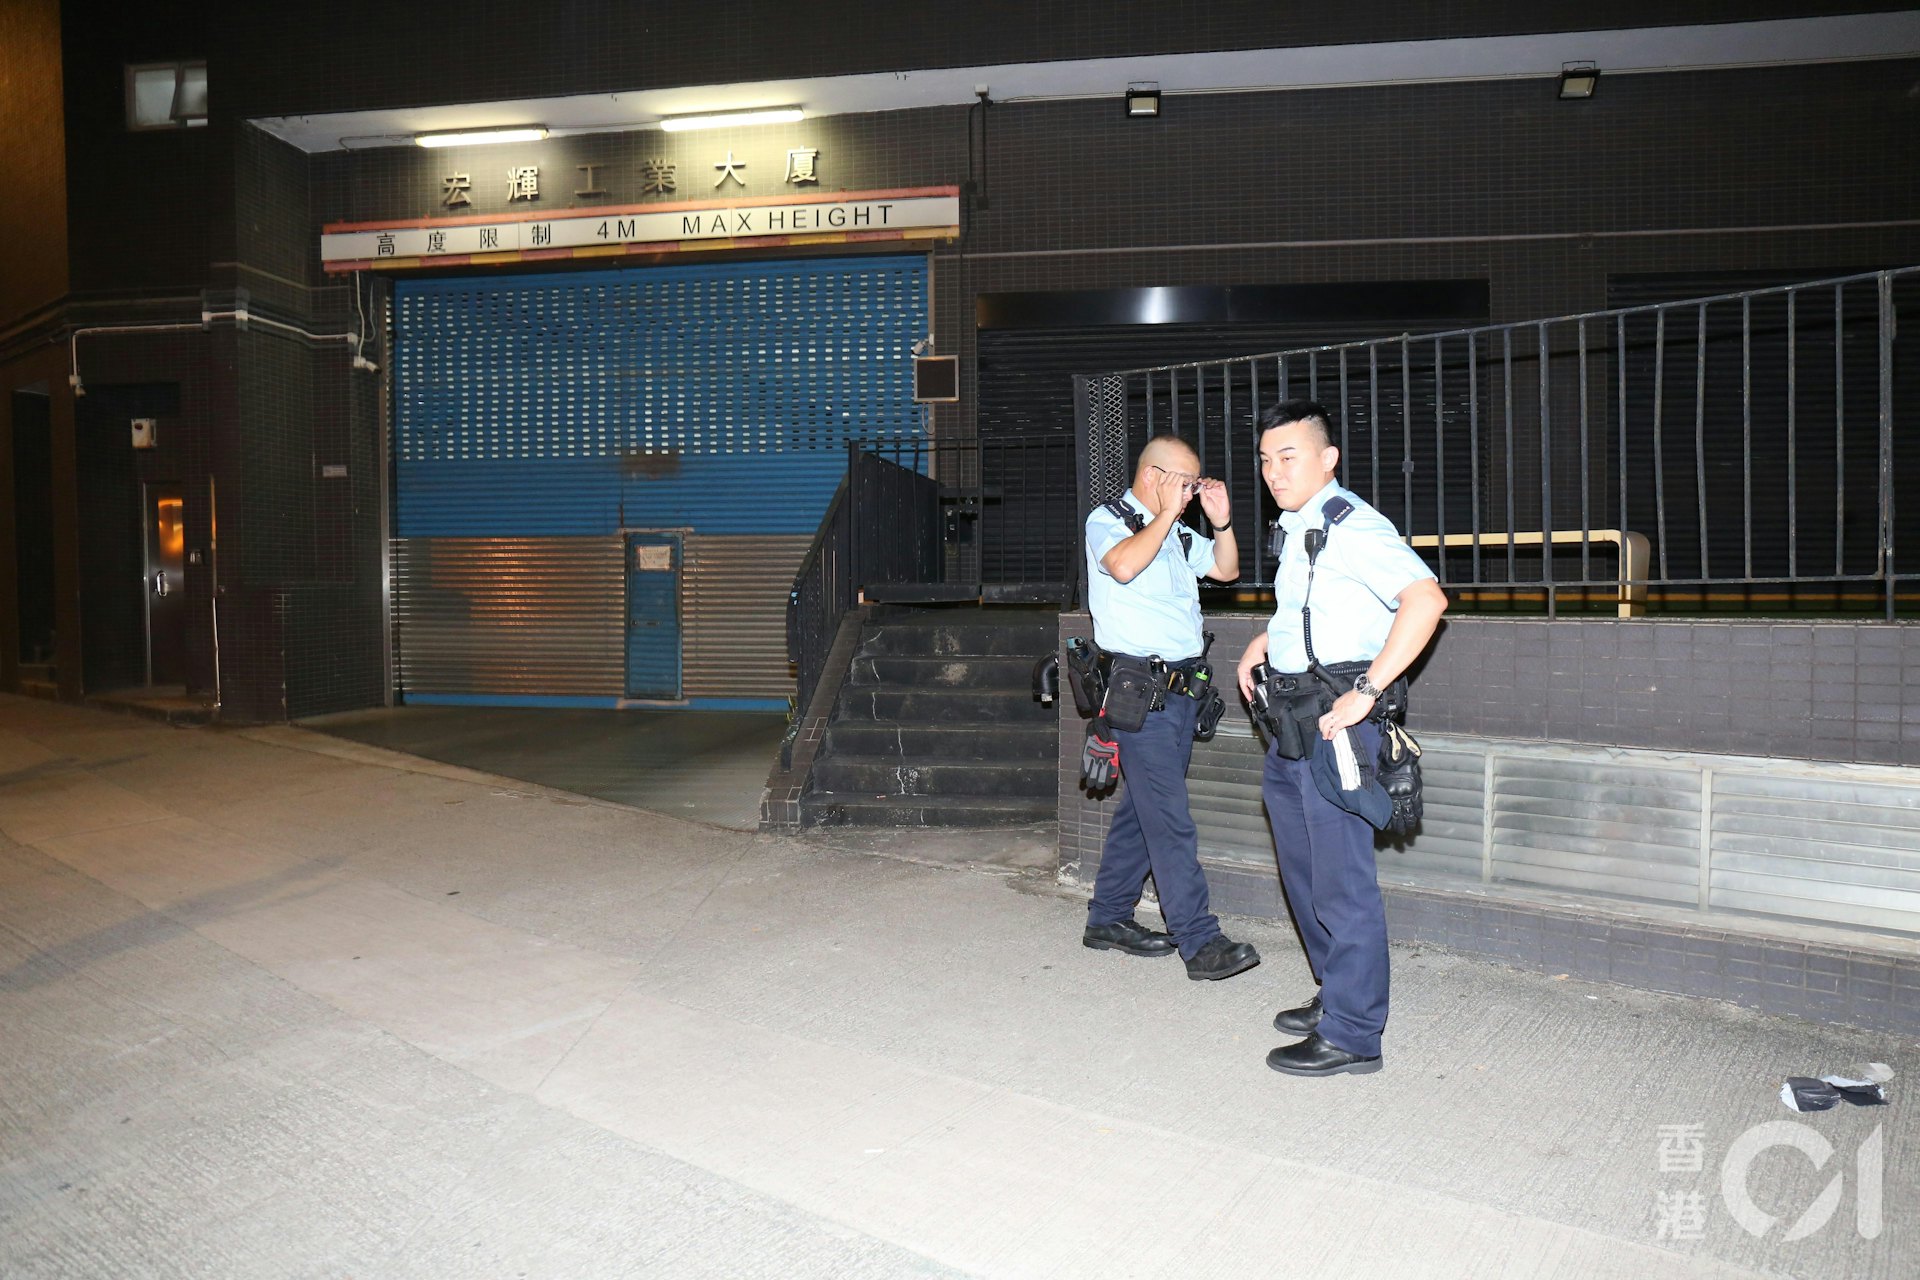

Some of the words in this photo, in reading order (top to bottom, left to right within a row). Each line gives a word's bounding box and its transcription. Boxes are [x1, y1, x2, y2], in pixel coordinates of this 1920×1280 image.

[442, 145, 819, 205] 宏輝工業大廈
[376, 223, 551, 257] 高度限制
[597, 219, 635, 239] 4M
[682, 212, 752, 234] MAX
[769, 204, 893, 230] HEIGHT
